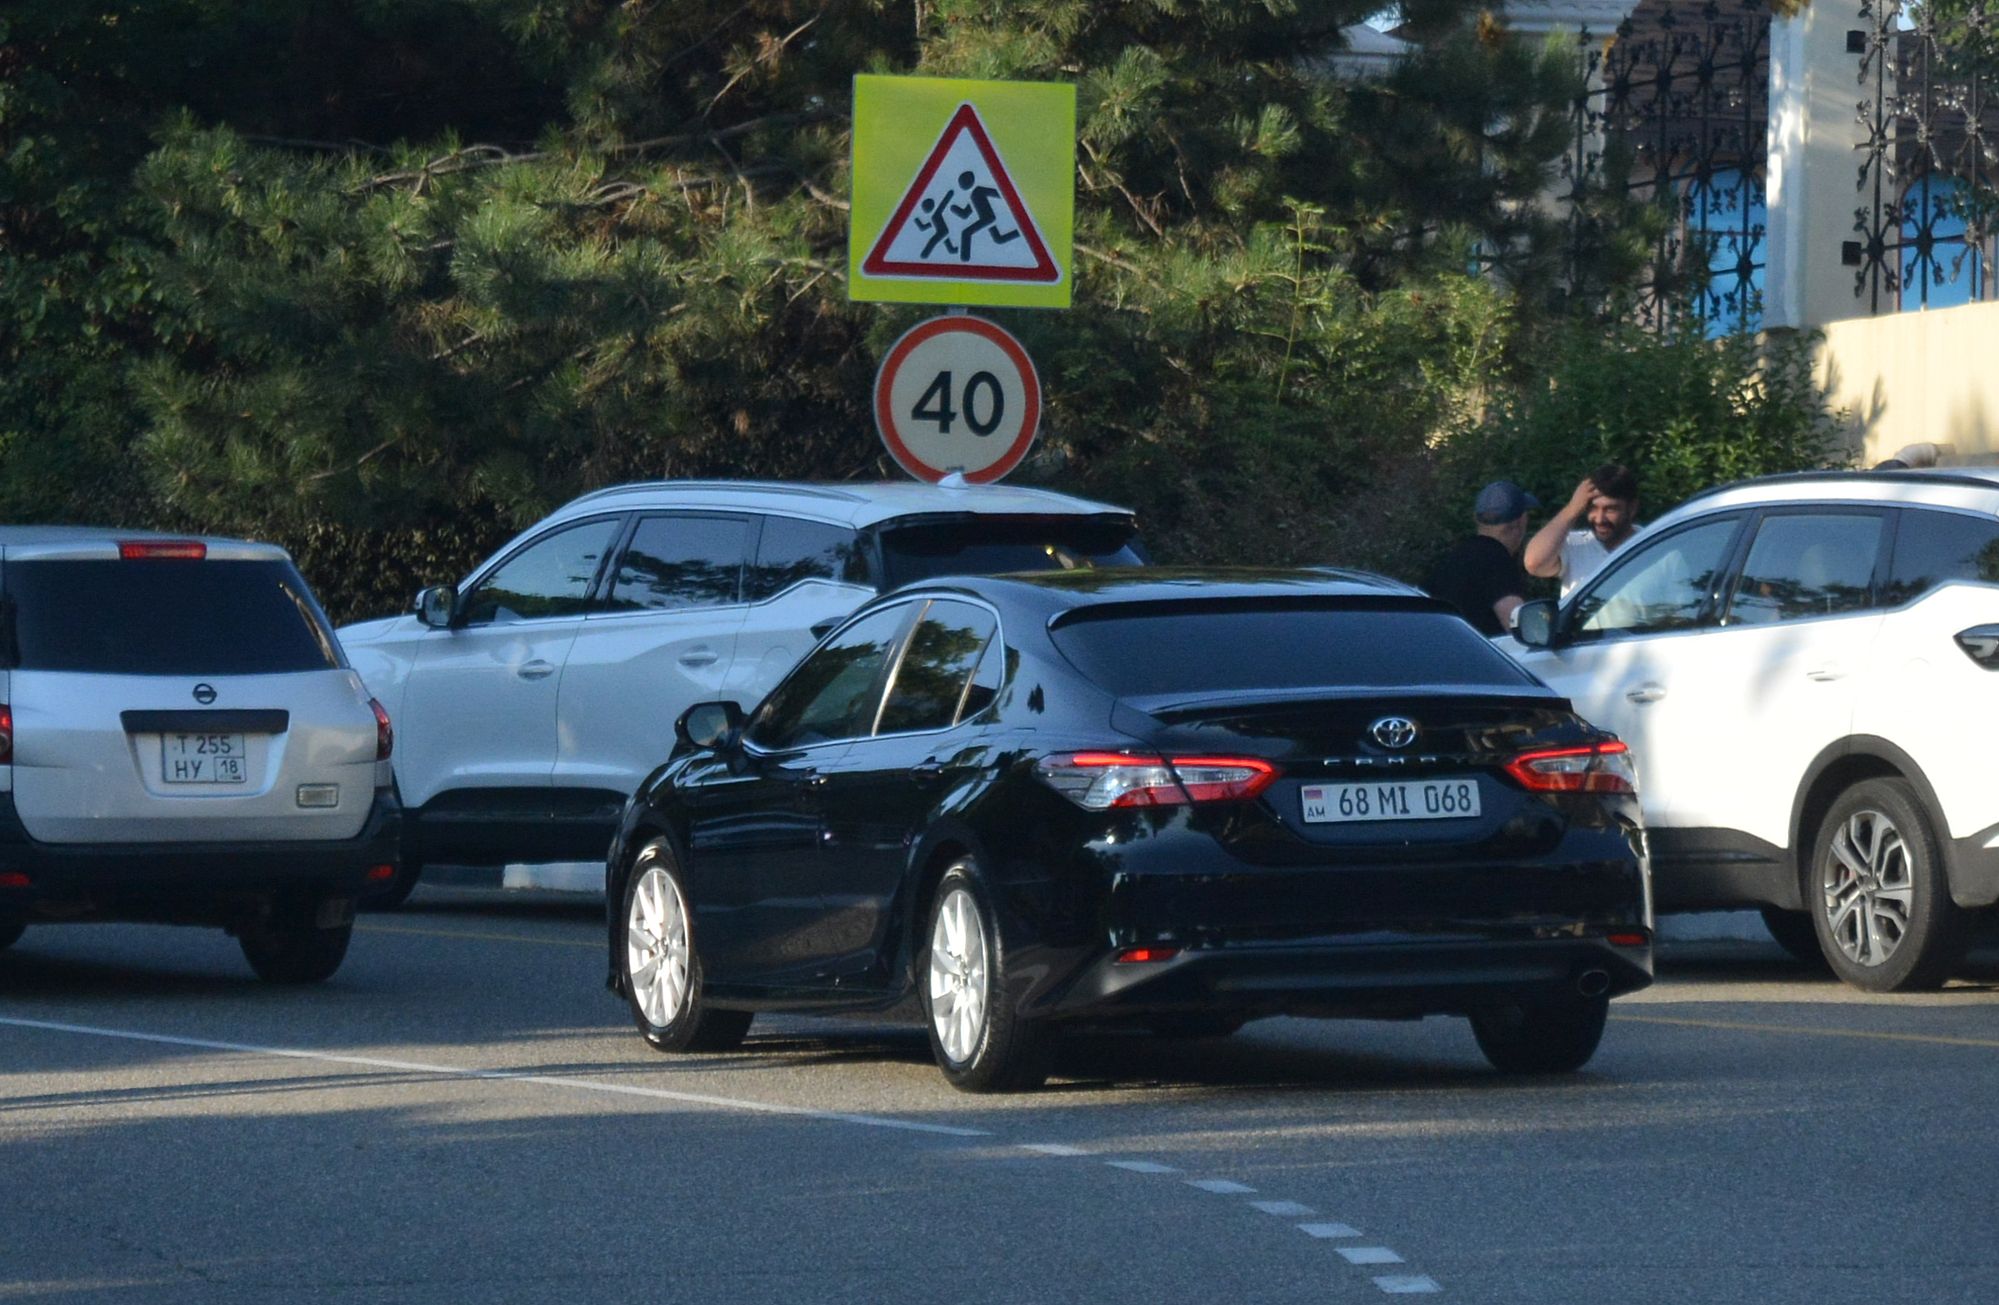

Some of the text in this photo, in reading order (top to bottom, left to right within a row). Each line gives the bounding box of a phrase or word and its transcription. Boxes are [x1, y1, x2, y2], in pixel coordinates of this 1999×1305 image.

[911, 371, 1004, 437] 40
[196, 735, 232, 754] 255
[220, 760, 239, 774] 18
[1339, 784, 1472, 816] 68 MI 068
[1307, 806, 1326, 818] AM
